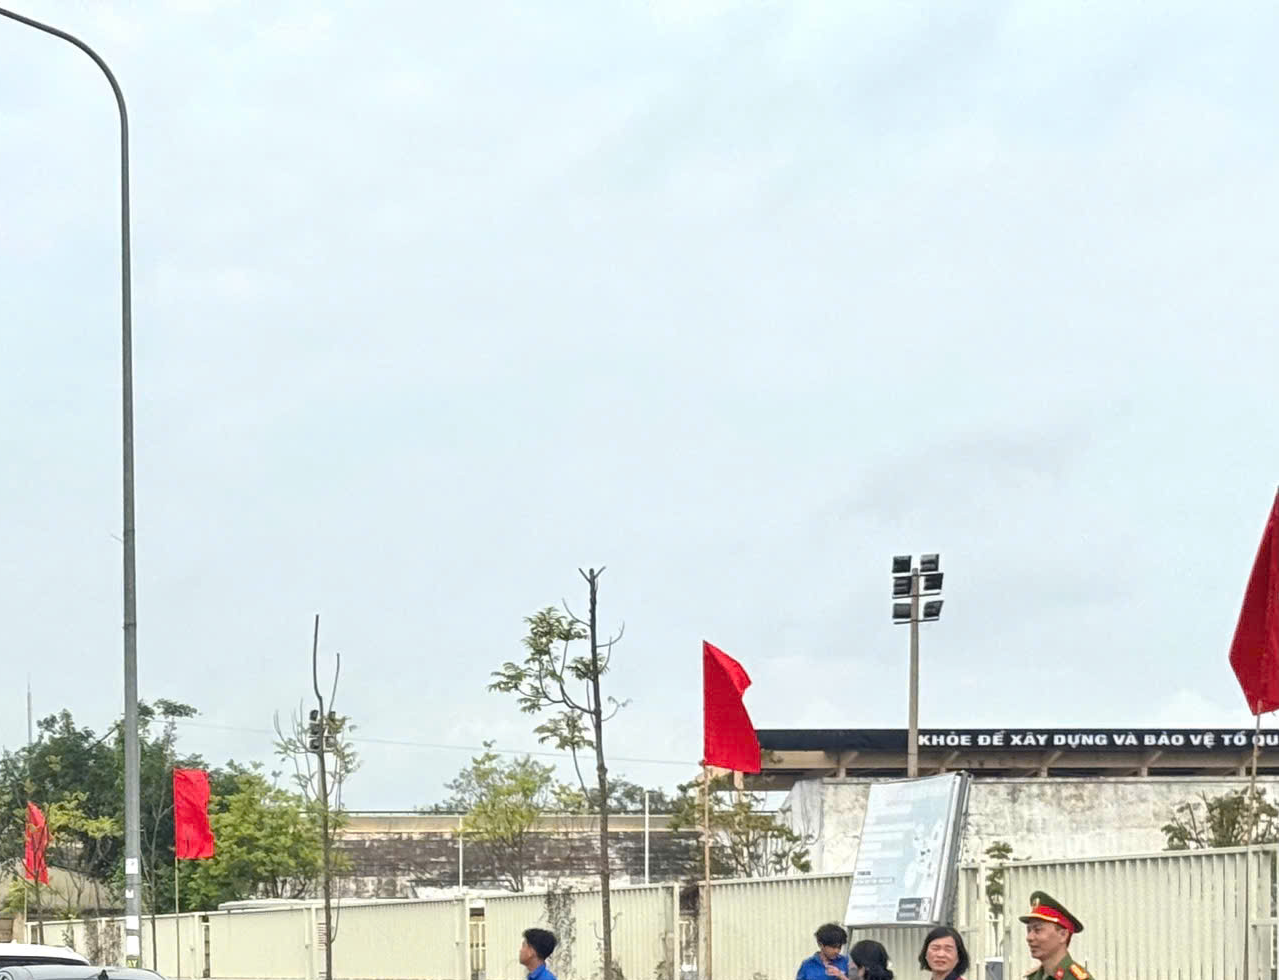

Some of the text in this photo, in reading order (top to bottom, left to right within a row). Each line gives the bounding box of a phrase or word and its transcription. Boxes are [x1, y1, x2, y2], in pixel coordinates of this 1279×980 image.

[918, 731, 972, 746] KHỎE
[977, 730, 1006, 746] ĐỂ
[1010, 731, 1048, 746] XÂY
[1053, 733, 1108, 749] DỰNG
[1113, 731, 1139, 746] VÀ
[1144, 730, 1185, 746] BẢO
[1189, 731, 1215, 749] VỆ
[1221, 730, 1247, 746] TỔ
